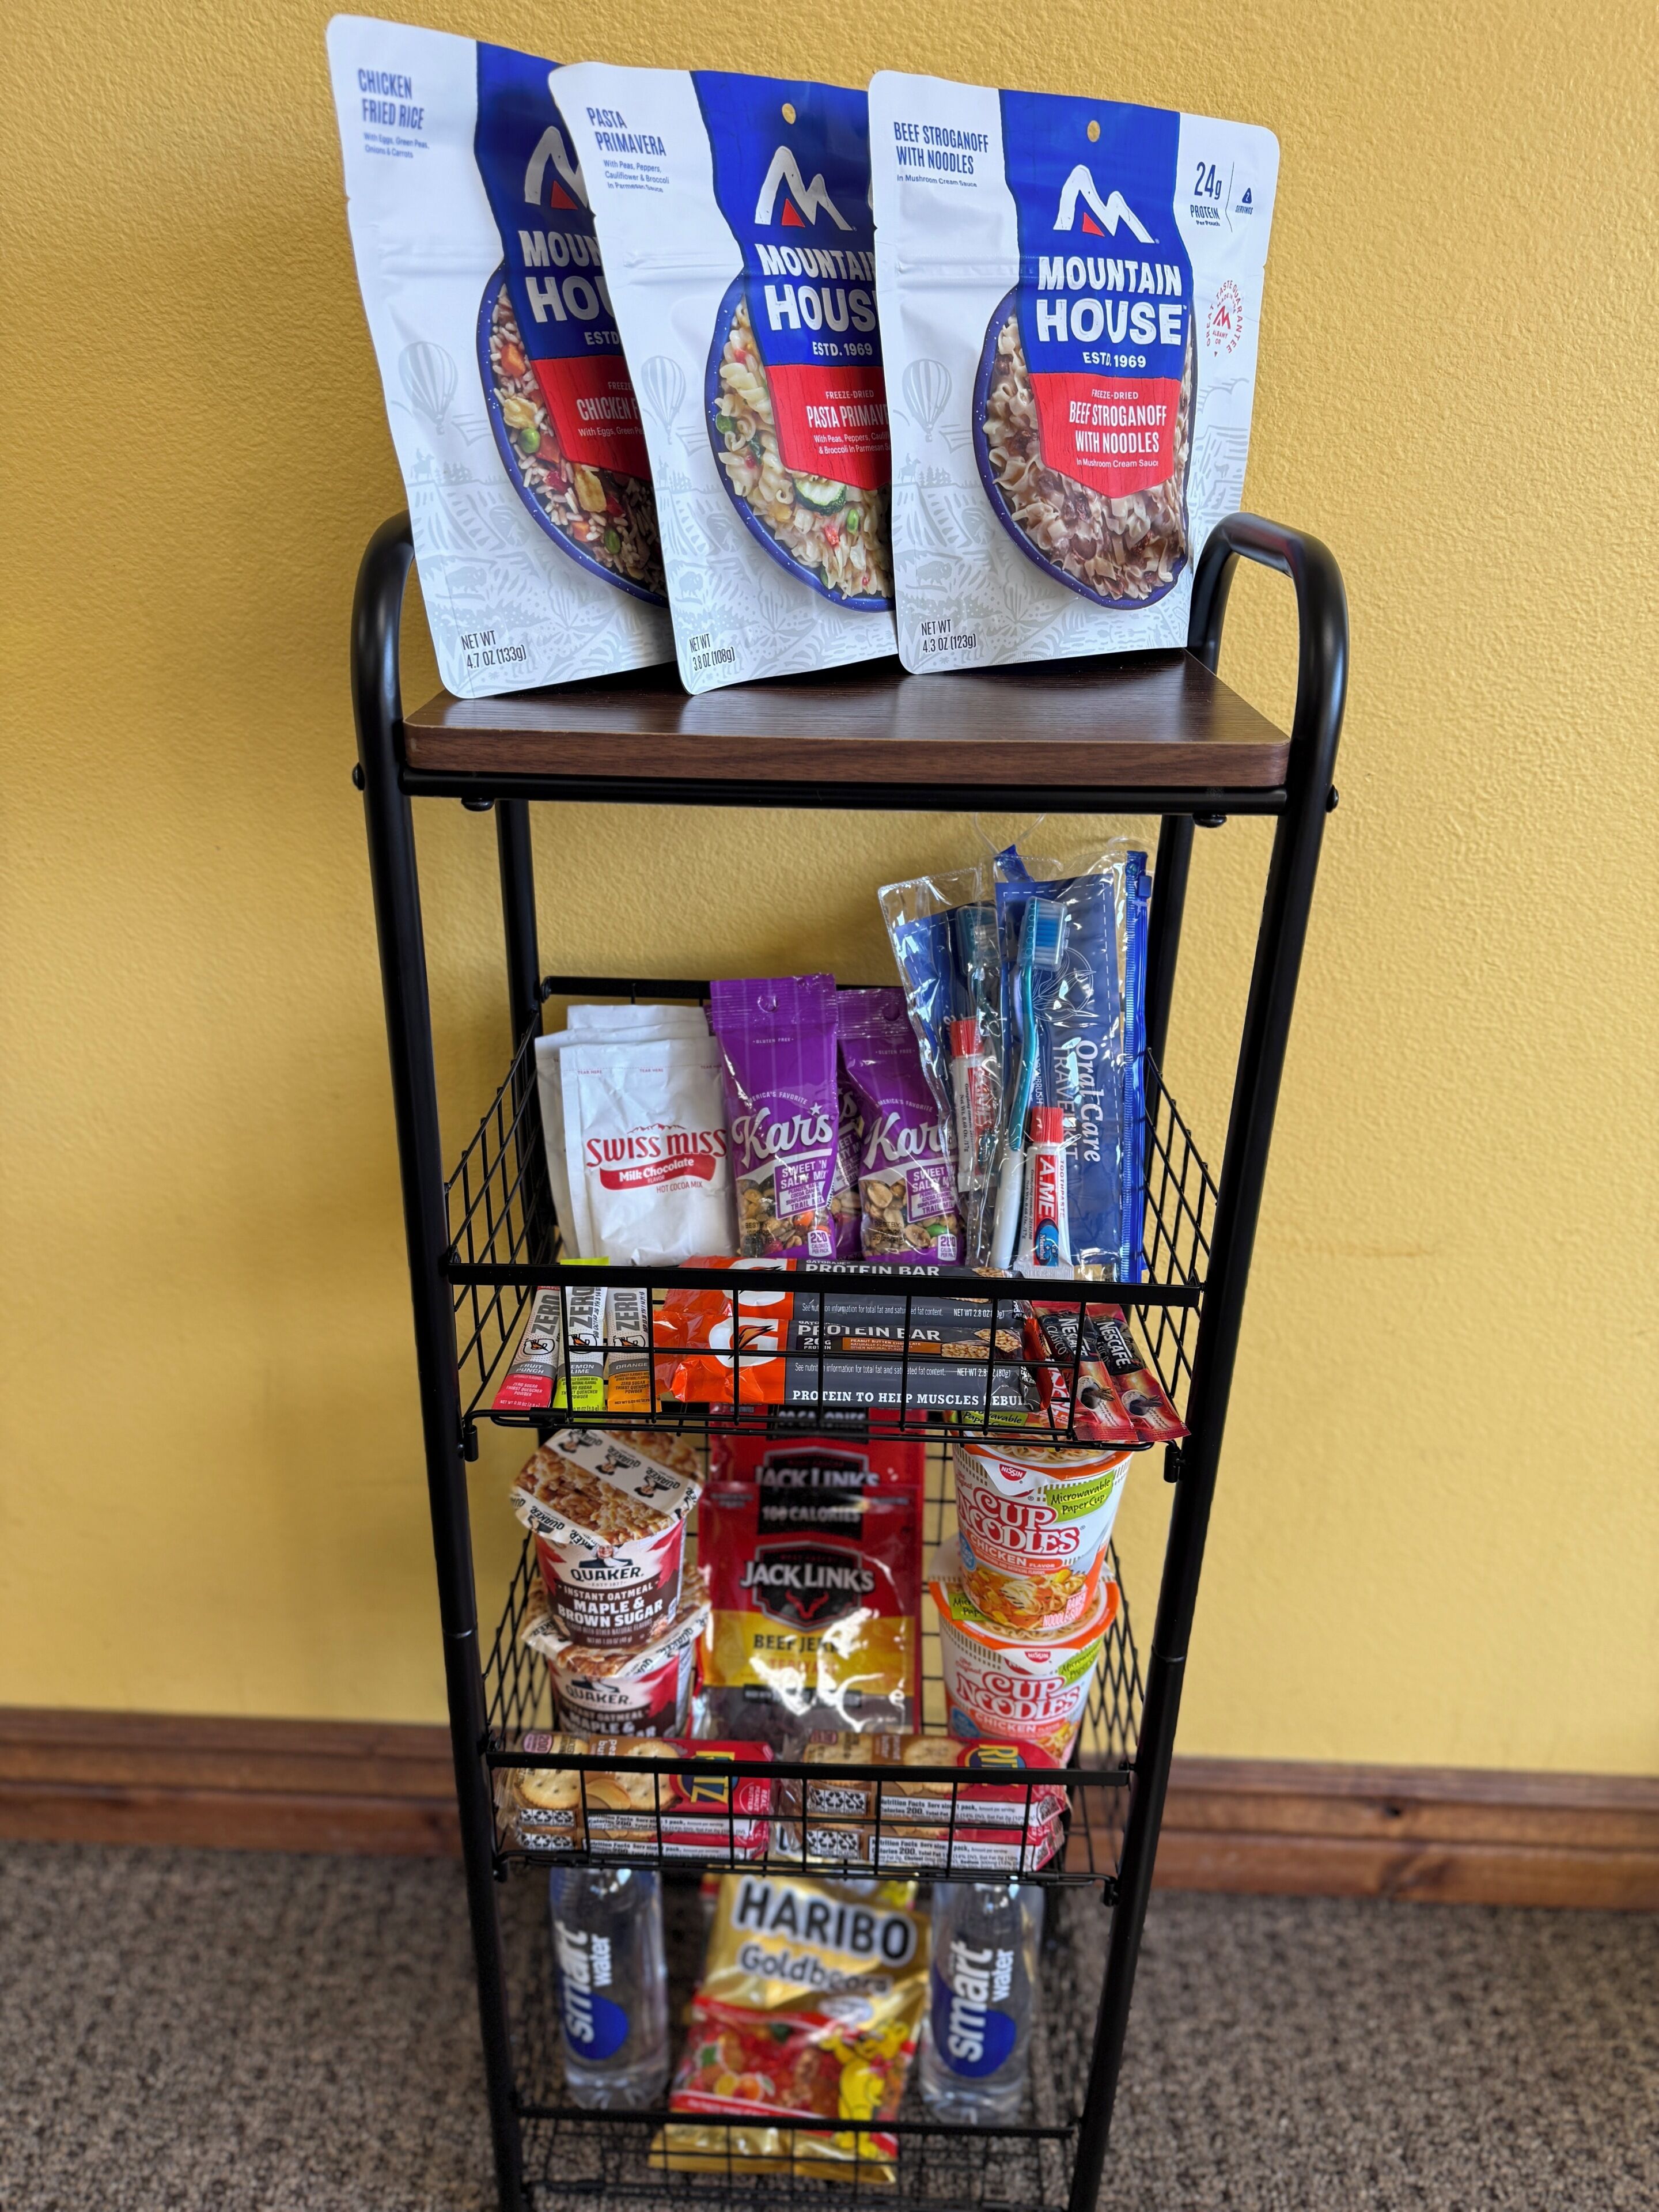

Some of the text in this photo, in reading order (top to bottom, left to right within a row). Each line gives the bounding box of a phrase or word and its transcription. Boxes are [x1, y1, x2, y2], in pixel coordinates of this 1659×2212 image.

[358, 68, 412, 100] CHICKEN
[362, 99, 424, 130] FRIED RICE
[586, 107, 628, 129] PASTA
[364, 132, 413, 146] With Green
[594, 131, 667, 157] PRIMAVERA
[893, 122, 988, 153] BEEF STROGANOFF
[365, 144, 413, 158] Onions Carrots
[896, 146, 974, 175] WITH NOODLES
[604, 160, 662, 173] With Peas, Peppers,
[605, 171, 670, 184] Cauliflower Broccoli
[905, 175, 938, 184] Mushroom
[1194, 161, 1222, 200] 24g
[1190, 204, 1221, 220] PROTEIN
[1235, 204, 1253, 215] SERVINGS
[755, 243, 876, 282] MOUNTAI
[1037, 256, 1183, 296] MOUNTAIN
[764, 284, 877, 332] HOUS
[1216, 280, 1233, 300] TASTE
[1226, 284, 1243, 354] GUARANTEE
[1036, 298, 1183, 346] HOUSE
[813, 341, 873, 357] ESTD. 1969
[1082, 351, 1146, 369] ESTD. 1969
[825, 390, 874, 399] FREEZE-DRIED
[1091, 389, 1139, 400] FREEZE-DRIED
[576, 397, 632, 421] CHICKEN
[806, 405, 840, 428] PASTA
[1069, 400, 1167, 427] BEEF STROGANOFF
[814, 435, 827, 443] With
[828, 435, 843, 444] Peas,
[844, 434, 870, 443] Peppers,
[824, 444, 884, 454] Broccoli Parmesan
[1075, 430, 1159, 454] WITH NOODLES
[1083, 459, 1159, 468] Mushroom Cream Sauce
[922, 619, 951, 636] NET WT
[461, 630, 496, 650] NET WT
[690, 634, 710, 653] NET WT
[923, 634, 976, 653] 4.3 OZ (123g)
[467, 644, 527, 669] 4.7 OZ (133g)
[693, 646, 735, 671] 3.8 OZ (108g)
[779, 1092, 808, 1105] FAVORITE
[906, 1101, 934, 1112] FAVORITE
[1075, 1040, 1104, 1162] Oral Care
[619, 1157, 694, 1183] Milk Chocolate
[648, 1176, 665, 1184] FLAVOR
[782, 1161, 816, 1178] SWEET
[814, 1171, 826, 1180] MIX
[657, 1181, 703, 1194] HOT COCOA MIX
[791, 1201, 809, 1211] TRAIL
[899, 1266, 940, 1276] BAR
[531, 1295, 560, 1335] ZERO
[569, 1287, 595, 1330] ZERO
[614, 1293, 640, 1331] ZERO
[802, 1303, 810, 1312] See
[831, 1305, 857, 1314] information
[865, 1305, 876, 1313] total
[885, 1306, 893, 1314] and
[925, 1308, 944, 1316] content.
[953, 1309, 990, 1317] NET WT 2.8 OZ
[856, 1392, 874, 1402] TO
[916, 1393, 979, 1405] MUSCLES
[1001, 1466, 1023, 1478] NISSIN
[1051, 1479, 1111, 1505] Microwavable
[974, 1487, 1057, 1529] CUP
[1062, 1494, 1105, 1514] Paper Cup
[958, 1487, 1080, 1555] NOODLES
[970, 1534, 1027, 1567] CHICKEN
[570, 1566, 641, 1582] QUAKER
[741, 1561, 801, 1588] JACK
[564, 1582, 653, 1601] INSTANT OATMEAL
[558, 1599, 663, 1627] BROWN SUGAR
[573, 1596, 644, 1615] MAPLE &
[753, 1634, 796, 1649] BEEF
[565, 1685, 627, 1705] QUAKER
[982, 1672, 1066, 1701] CUP
[975, 1711, 1036, 1733] CHICKEN
[735, 1879, 915, 1961] HARIBO
[593, 1934, 611, 1987] water
[555, 1921, 594, 2044] smart
[991, 1948, 1014, 2002] water
[949, 1941, 992, 2062] smart
